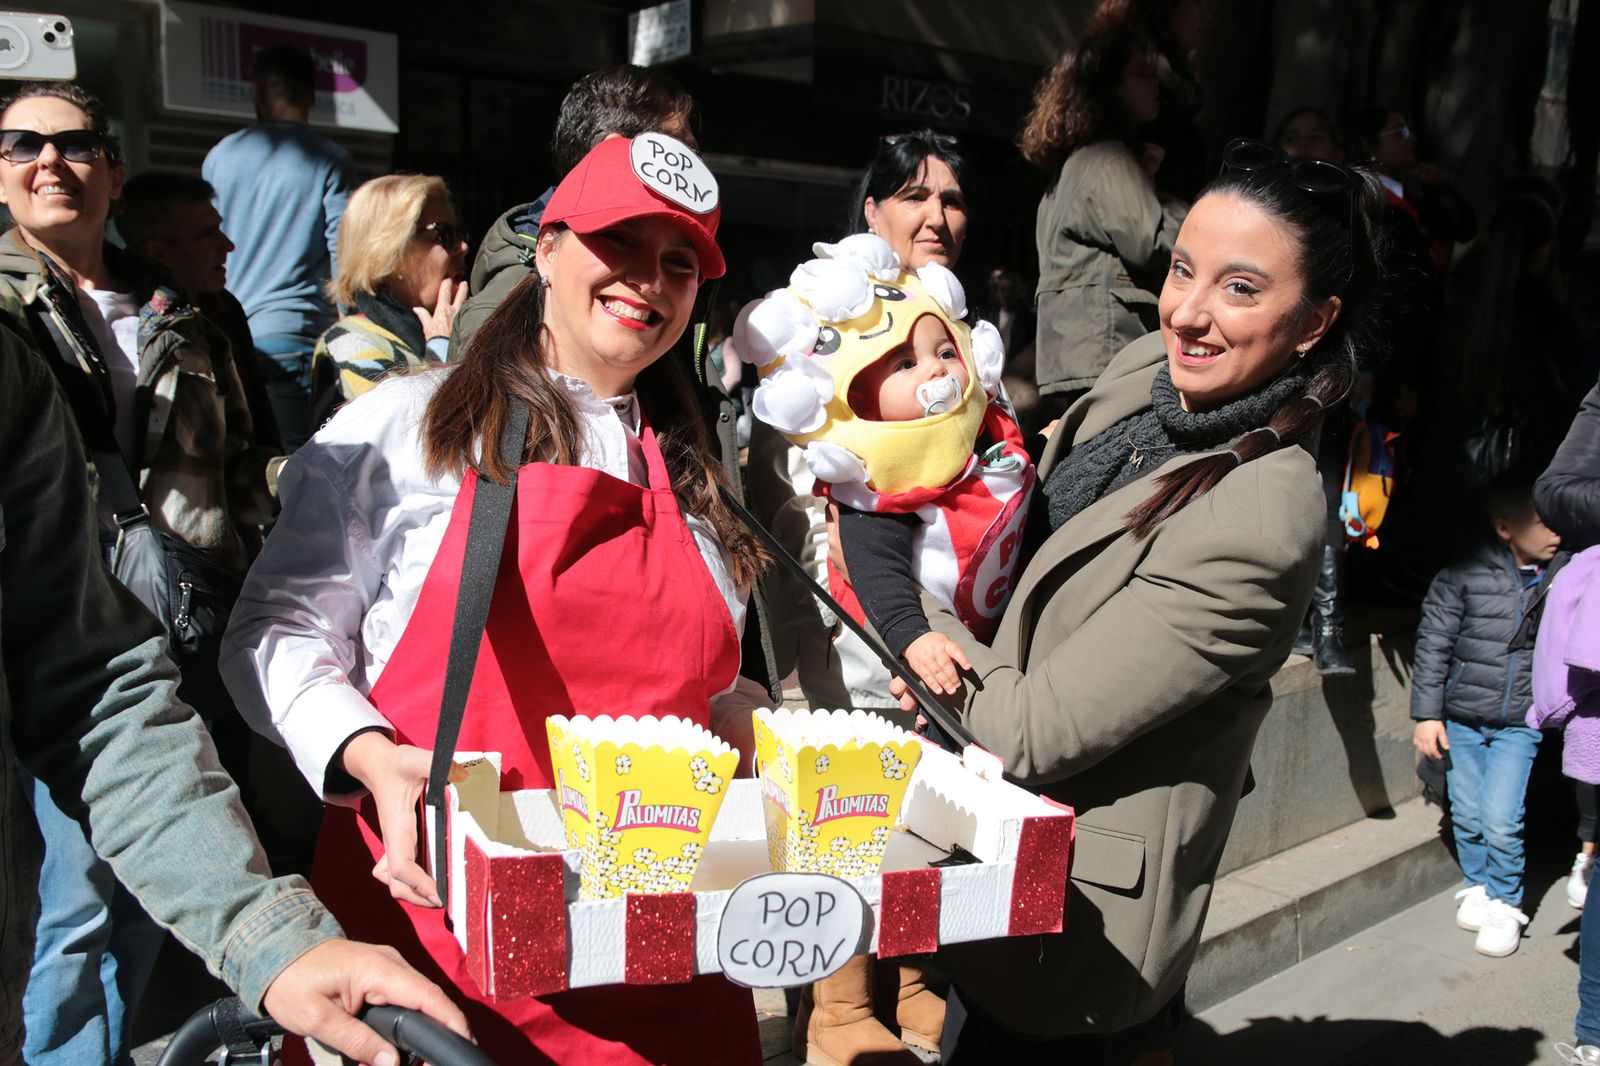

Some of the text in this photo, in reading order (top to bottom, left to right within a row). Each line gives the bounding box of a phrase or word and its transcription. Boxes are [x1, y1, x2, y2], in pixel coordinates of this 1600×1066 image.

[881, 74, 971, 119] RIZOS
[647, 139, 693, 172] POP
[640, 161, 713, 202] CORN
[614, 789, 702, 829] PALOMITAS
[814, 784, 890, 823] PALOMITAS
[758, 891, 836, 927] POP
[730, 938, 845, 977] CORN
